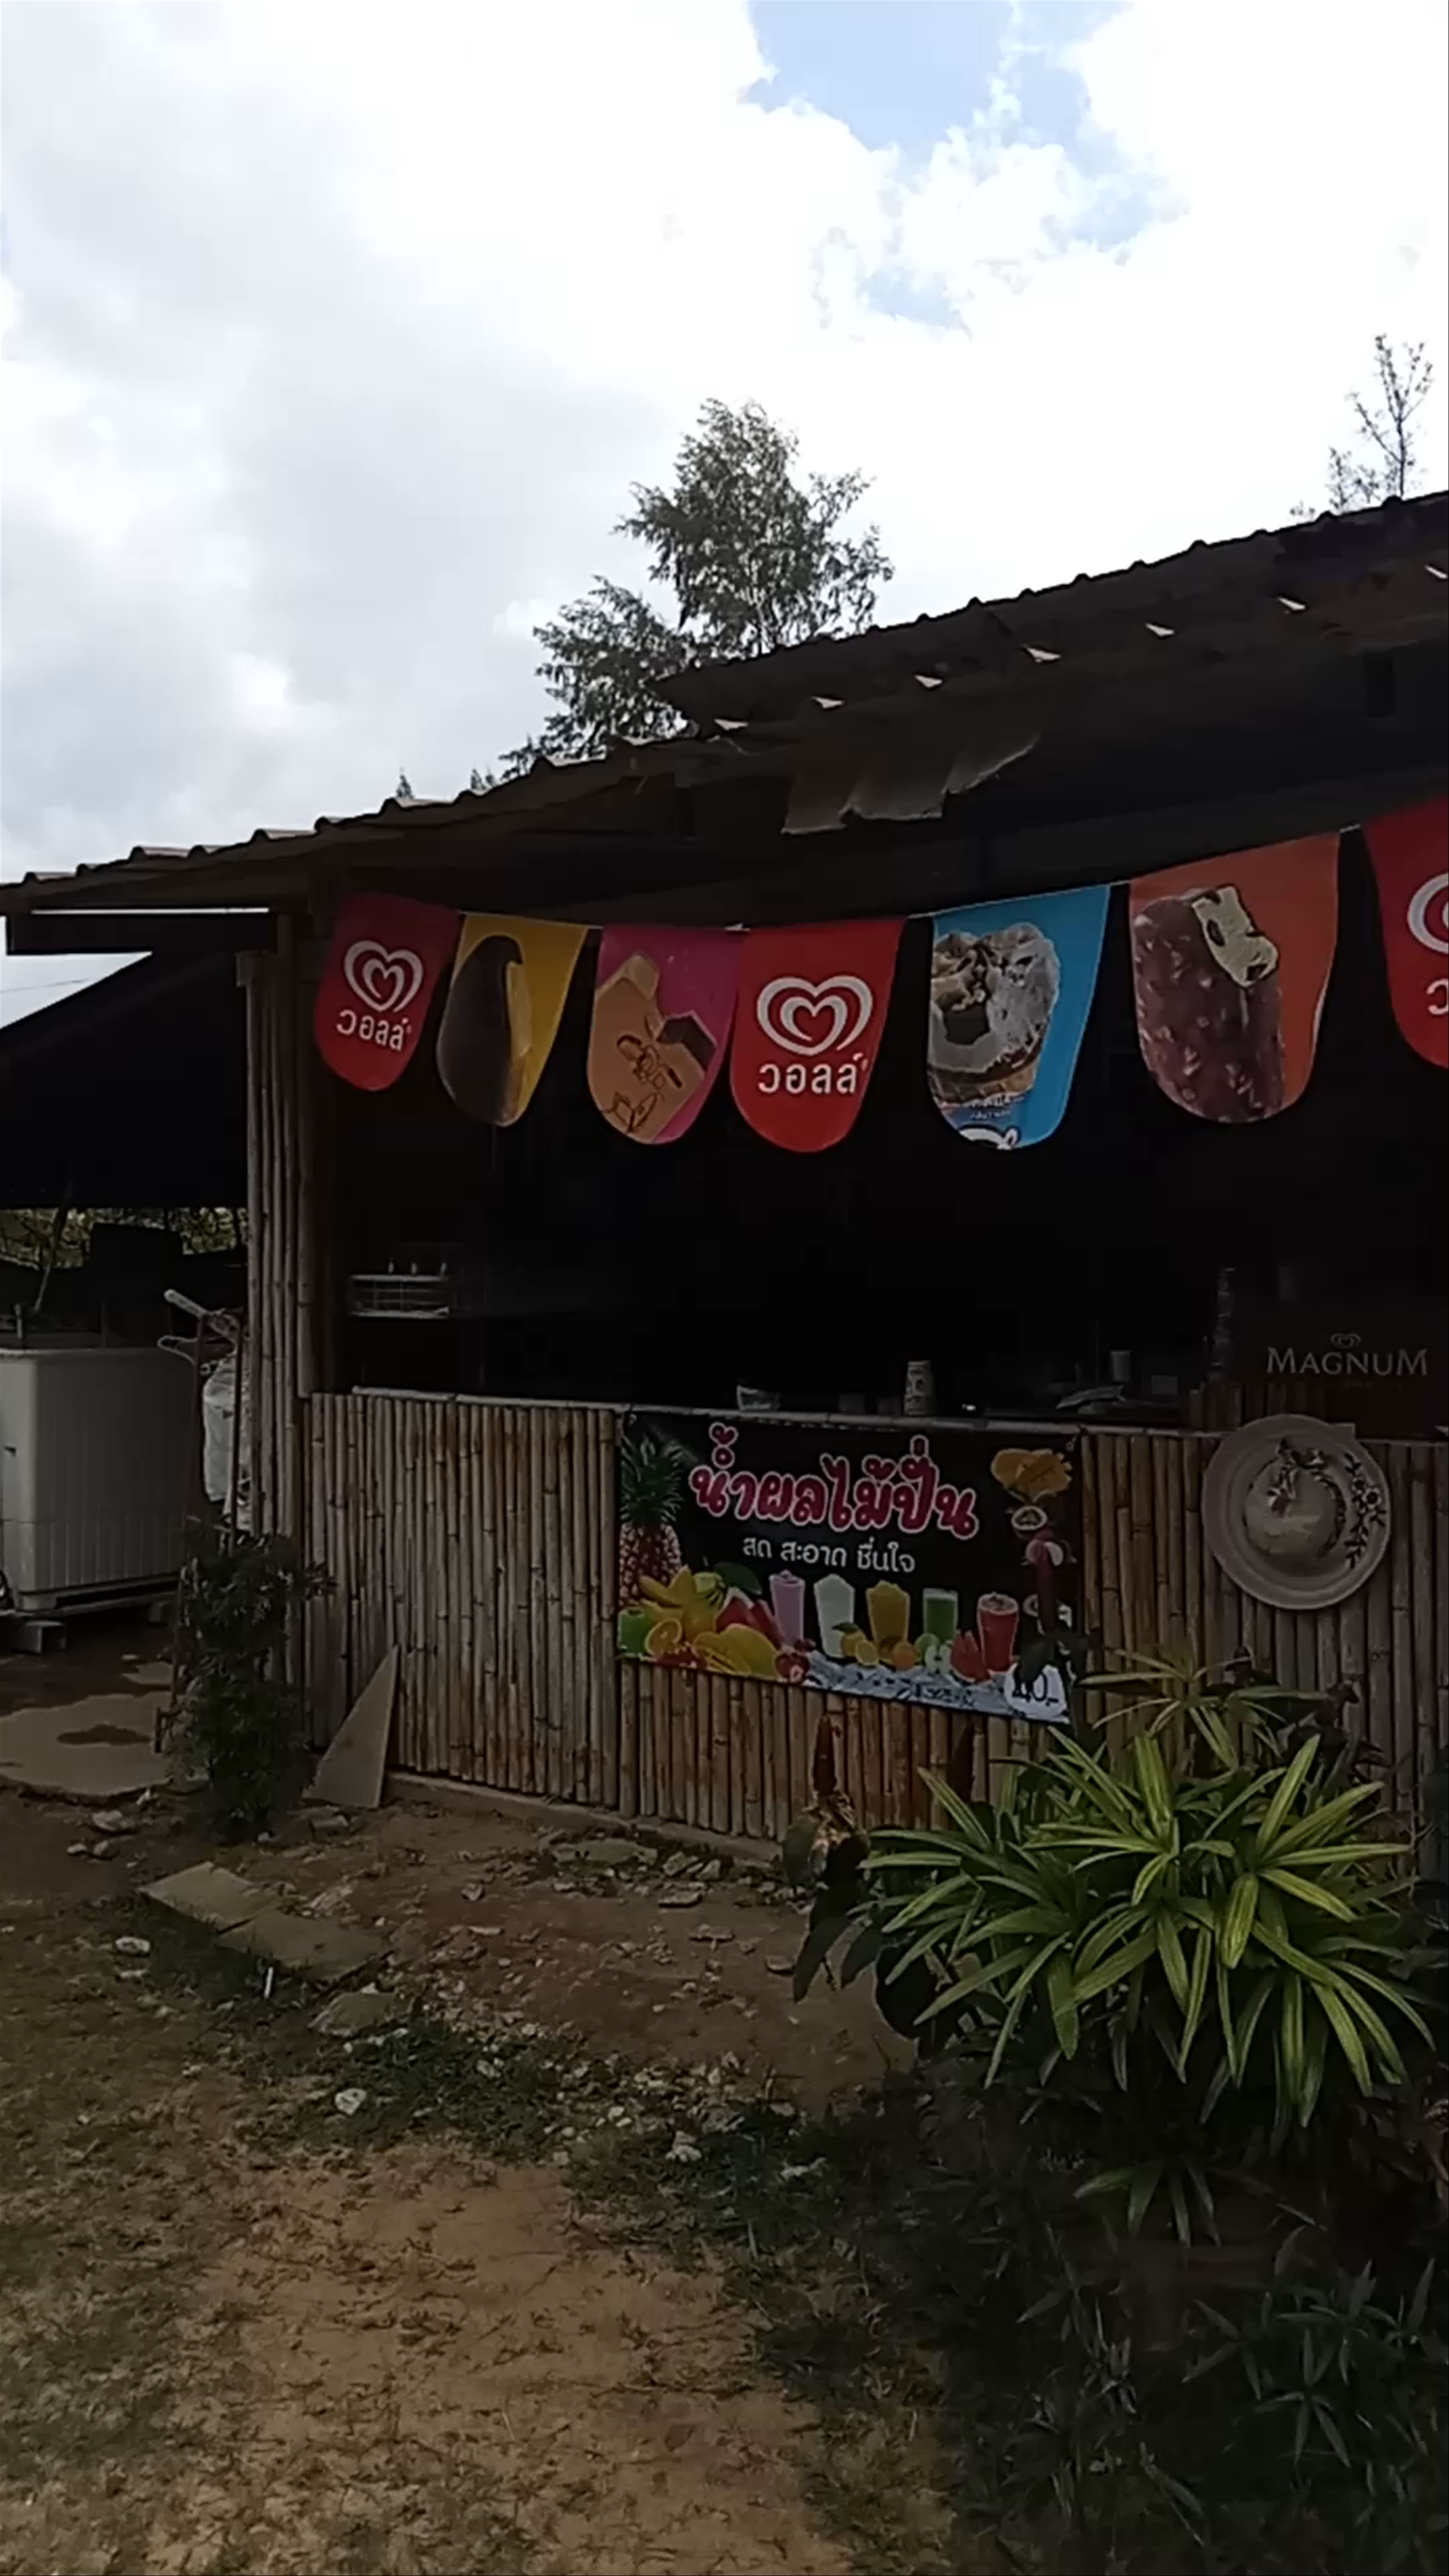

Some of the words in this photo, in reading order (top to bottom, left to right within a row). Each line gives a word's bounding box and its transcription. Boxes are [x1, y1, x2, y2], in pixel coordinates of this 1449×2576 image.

[336, 1009, 412, 1052] วอลล์
[758, 1052, 869, 1094] วอลล์
[1266, 1346, 1428, 1376] MAGNUM
[688, 1422, 980, 1539] น้ำผลไม้ปั่น
[742, 1536, 772, 1559] สด
[780, 1542, 848, 1567] สะอาด
[857, 1536, 916, 1573] ชื่นใจ
